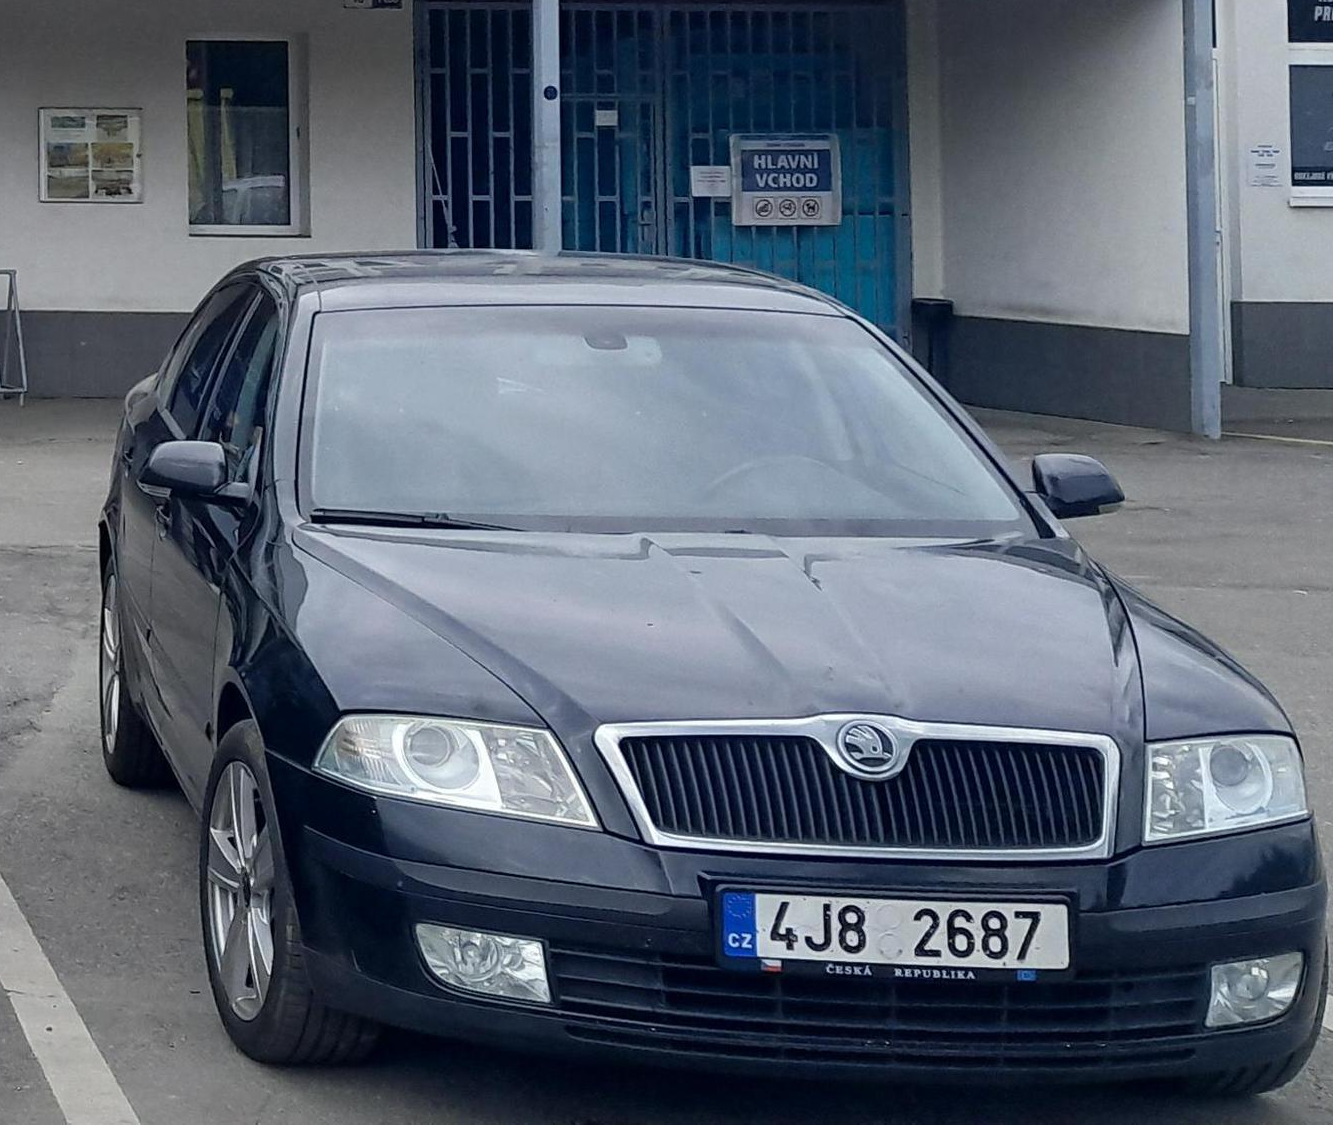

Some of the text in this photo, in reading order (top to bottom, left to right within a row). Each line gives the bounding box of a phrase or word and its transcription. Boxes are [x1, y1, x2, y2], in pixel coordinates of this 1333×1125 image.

[753, 152, 819, 170] HLAVNÍ
[756, 173, 818, 188] VCHOD
[769, 901, 1042, 962] 4J8 2687
[727, 933, 753, 950] CZ
[825, 962, 976, 981] ČESKÁ REPUBLIKA
